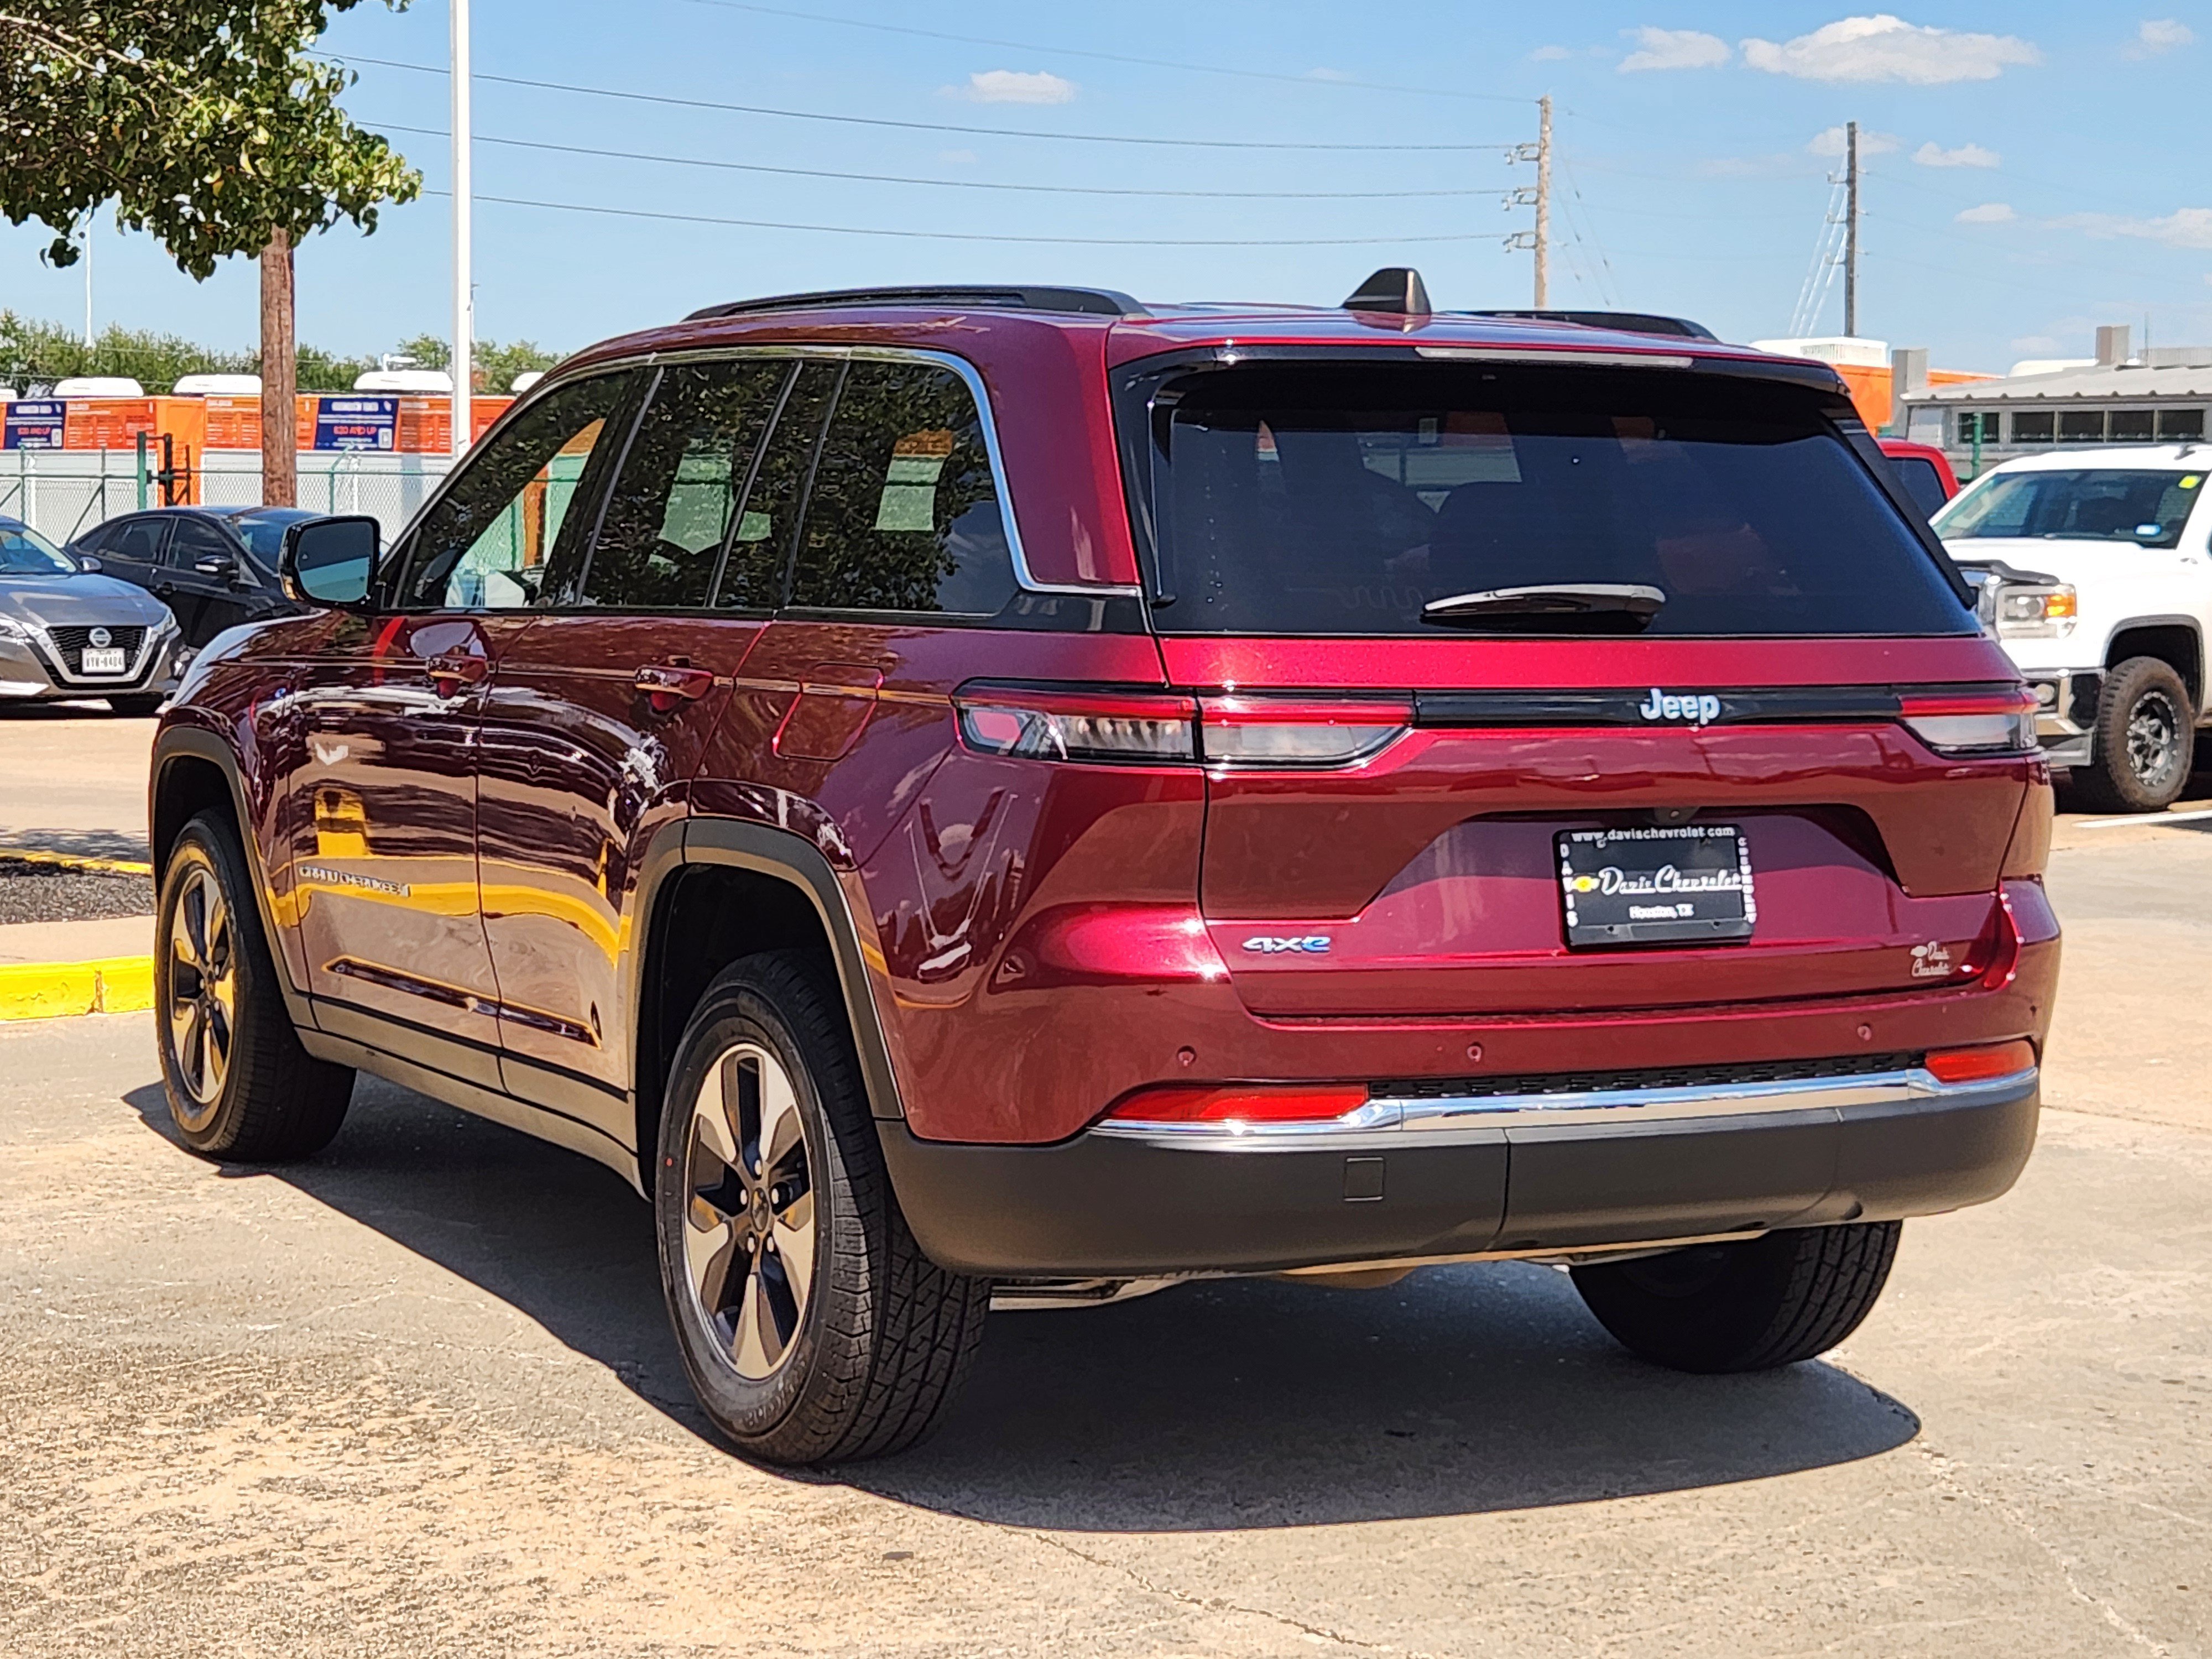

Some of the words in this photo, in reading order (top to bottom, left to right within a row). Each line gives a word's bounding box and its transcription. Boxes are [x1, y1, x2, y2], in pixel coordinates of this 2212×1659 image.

[1639, 687, 1720, 725] Jeep
[1559, 843, 1578, 928] DAVIS
[1598, 866, 1656, 895] Davis
[1654, 864, 1743, 893] Chevrolet
